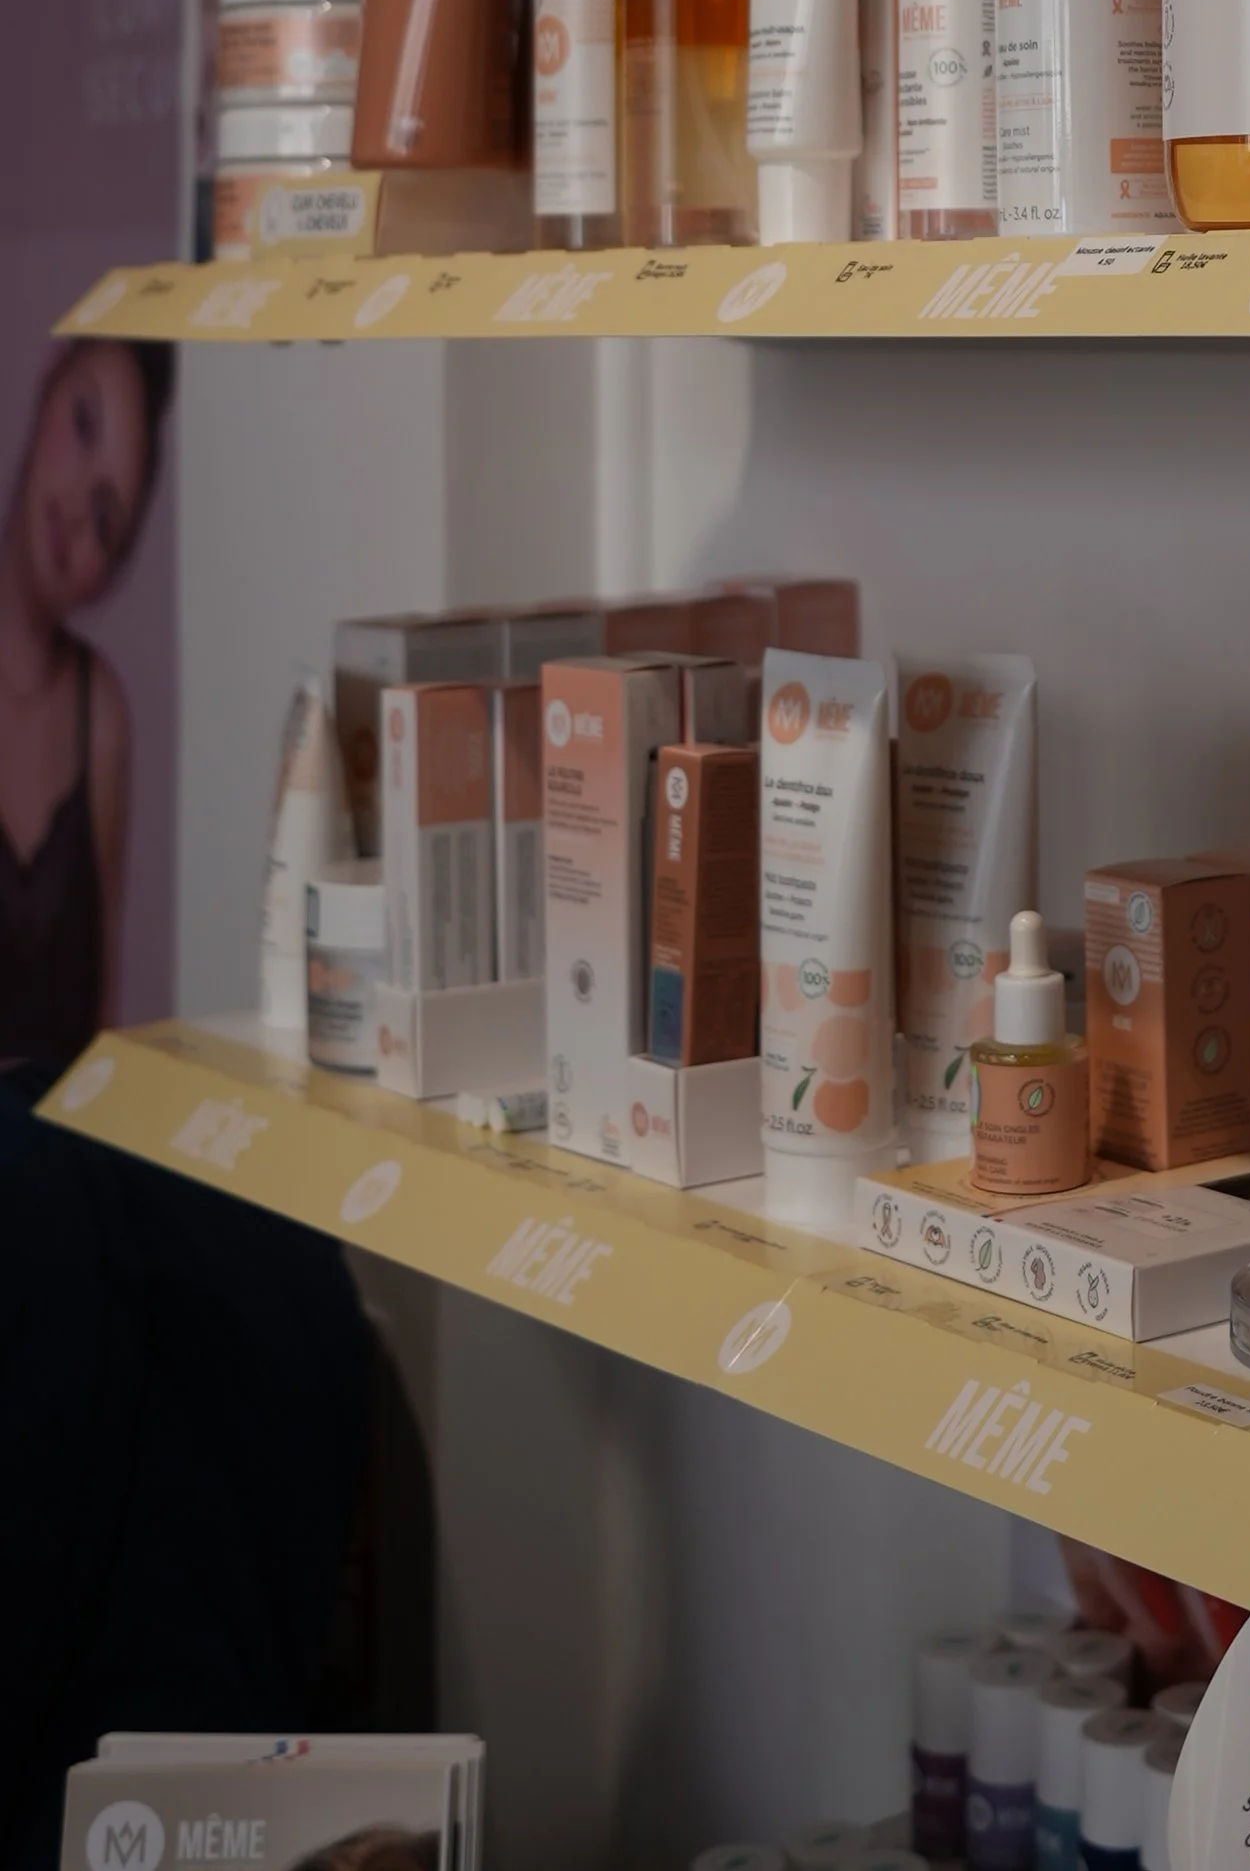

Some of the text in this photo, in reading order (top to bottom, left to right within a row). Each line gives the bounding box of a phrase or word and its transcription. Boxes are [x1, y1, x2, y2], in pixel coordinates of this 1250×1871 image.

[902, 2, 948, 34] MÊME
[1020, 39, 1038, 52] soin
[1011, 124, 1030, 137] mist
[917, 252, 1061, 320] MÊME
[487, 1212, 614, 1308] MÊME
[925, 1378, 1093, 1497] MÊME
[177, 1811, 267, 1861] MÊME
